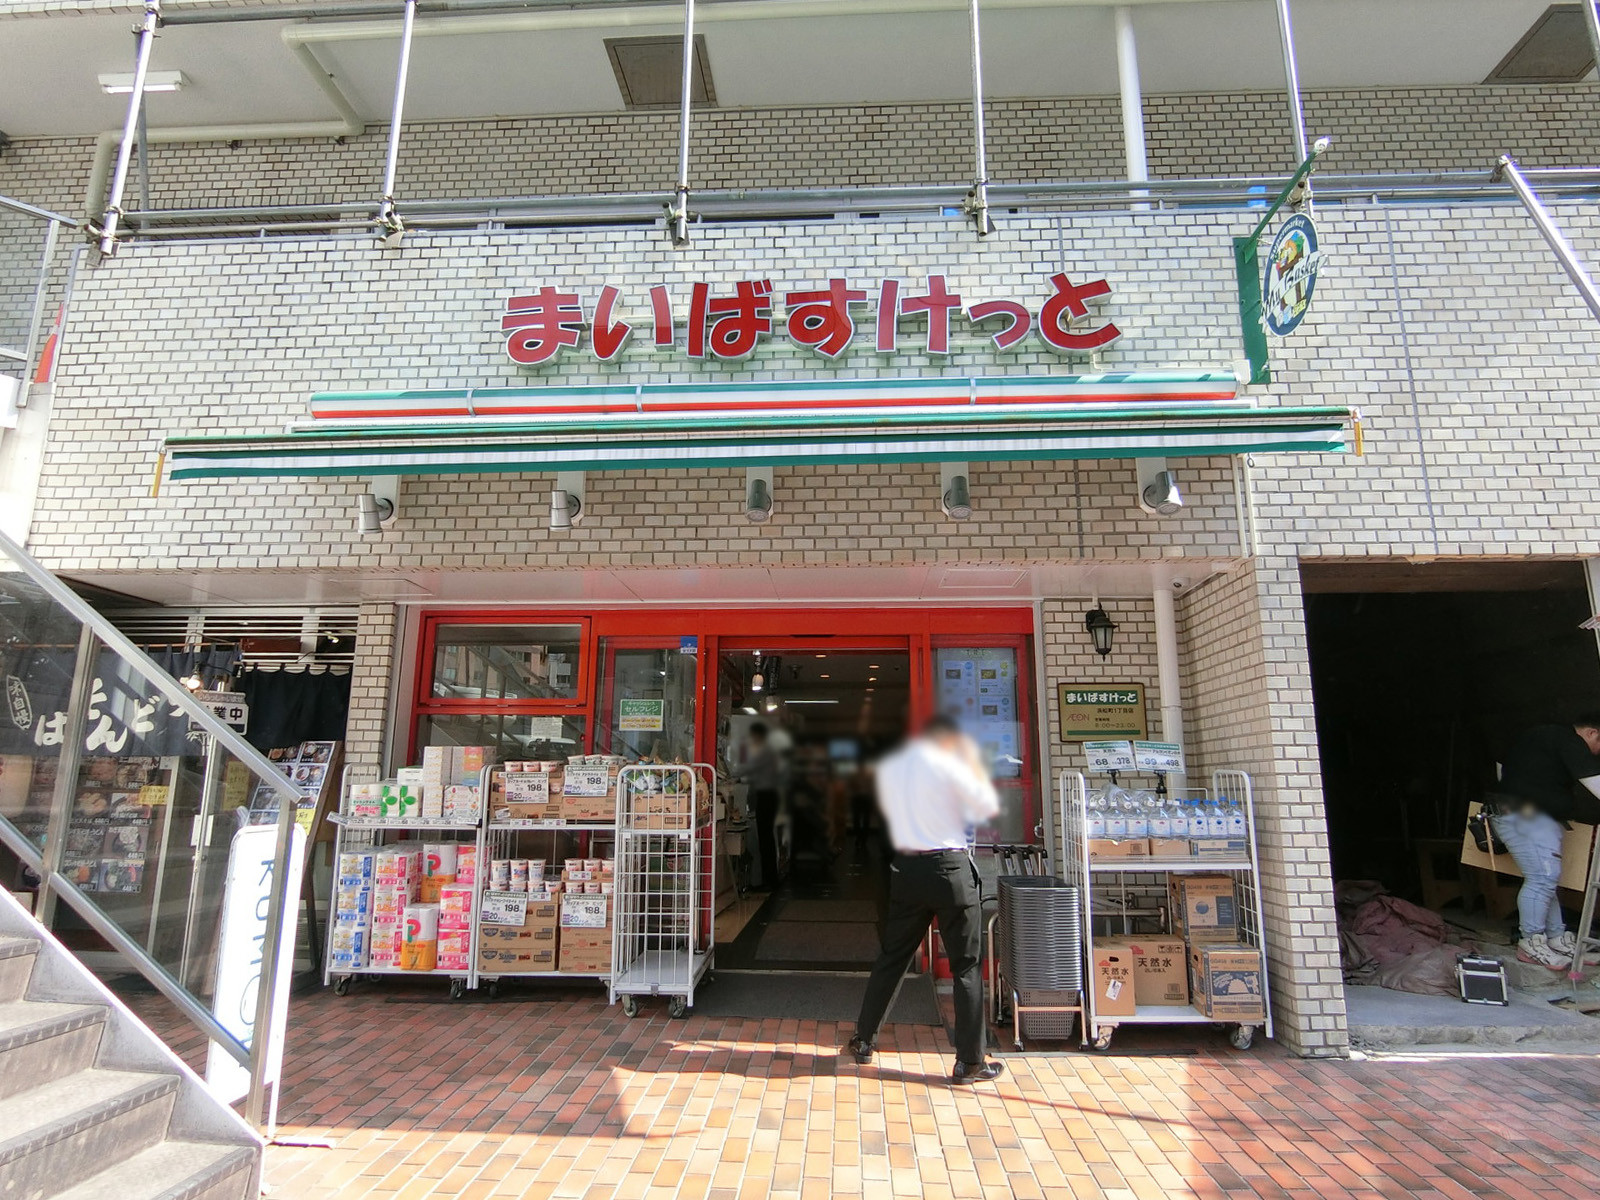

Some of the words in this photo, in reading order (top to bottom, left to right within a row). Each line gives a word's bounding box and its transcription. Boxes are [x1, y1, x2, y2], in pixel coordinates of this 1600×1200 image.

[501, 272, 1121, 365] まいばすけっと
[1066, 692, 1137, 703] まいばすけっと
[624, 705, 659, 713] セルフレジ
[1095, 758, 1109, 766] 68
[586, 777, 602, 785] 198
[527, 783, 542, 791] 198
[504, 904, 520, 912] 198
[584, 906, 600, 914] 198
[1138, 957, 1172, 967] 天然水
[1101, 967, 1129, 975] 天然水
